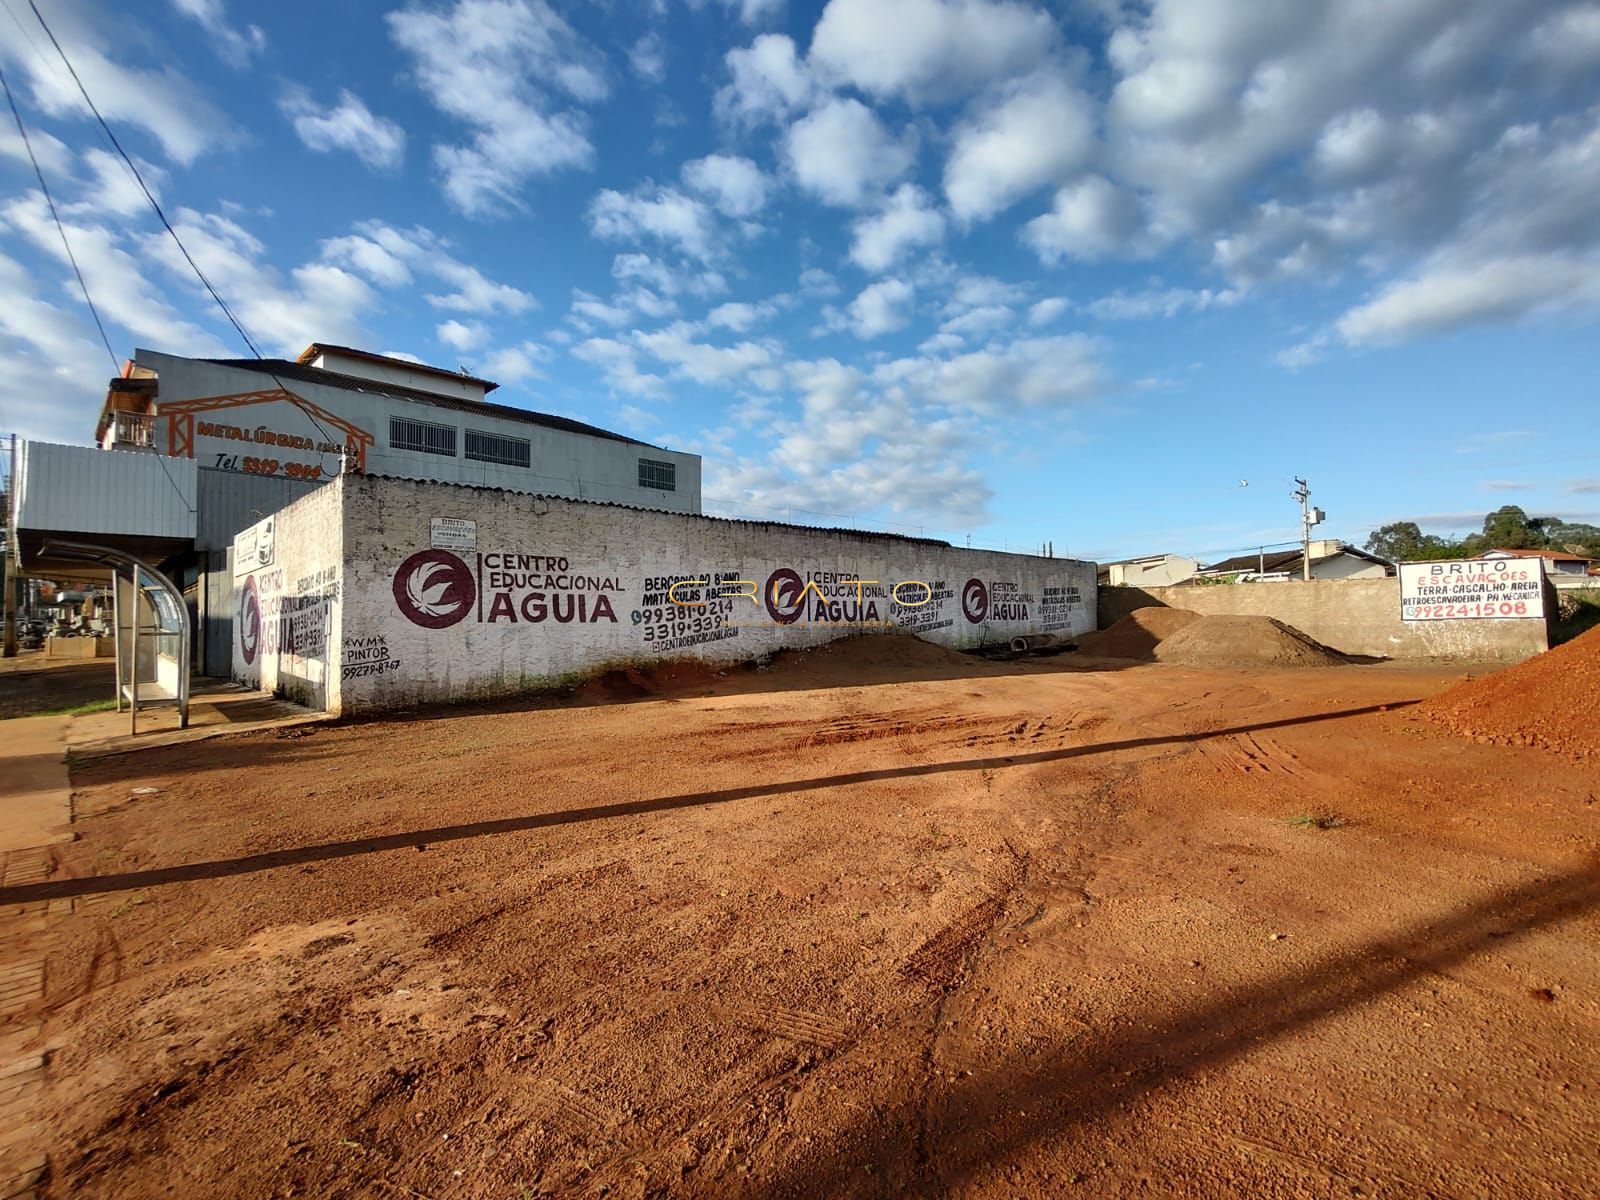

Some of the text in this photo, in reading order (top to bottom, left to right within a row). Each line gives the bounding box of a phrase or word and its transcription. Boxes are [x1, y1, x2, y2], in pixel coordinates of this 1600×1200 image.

[197, 421, 314, 451] METALÚRGICA
[215, 453, 237, 470] Tel.
[484, 553, 568, 571] CENTRO
[1431, 562, 1507, 575] BRITO
[490, 572, 625, 591] EDUCACIONAL
[813, 571, 860, 584] CENTRO
[815, 585, 888, 598] EDUCACIONAL
[992, 582, 1019, 593] CENTRO
[1417, 581, 1539, 596] TERRA CASCALHO AREIA
[488, 587, 617, 623] ÁGUIA
[347, 646, 390, 663] PINTOR
